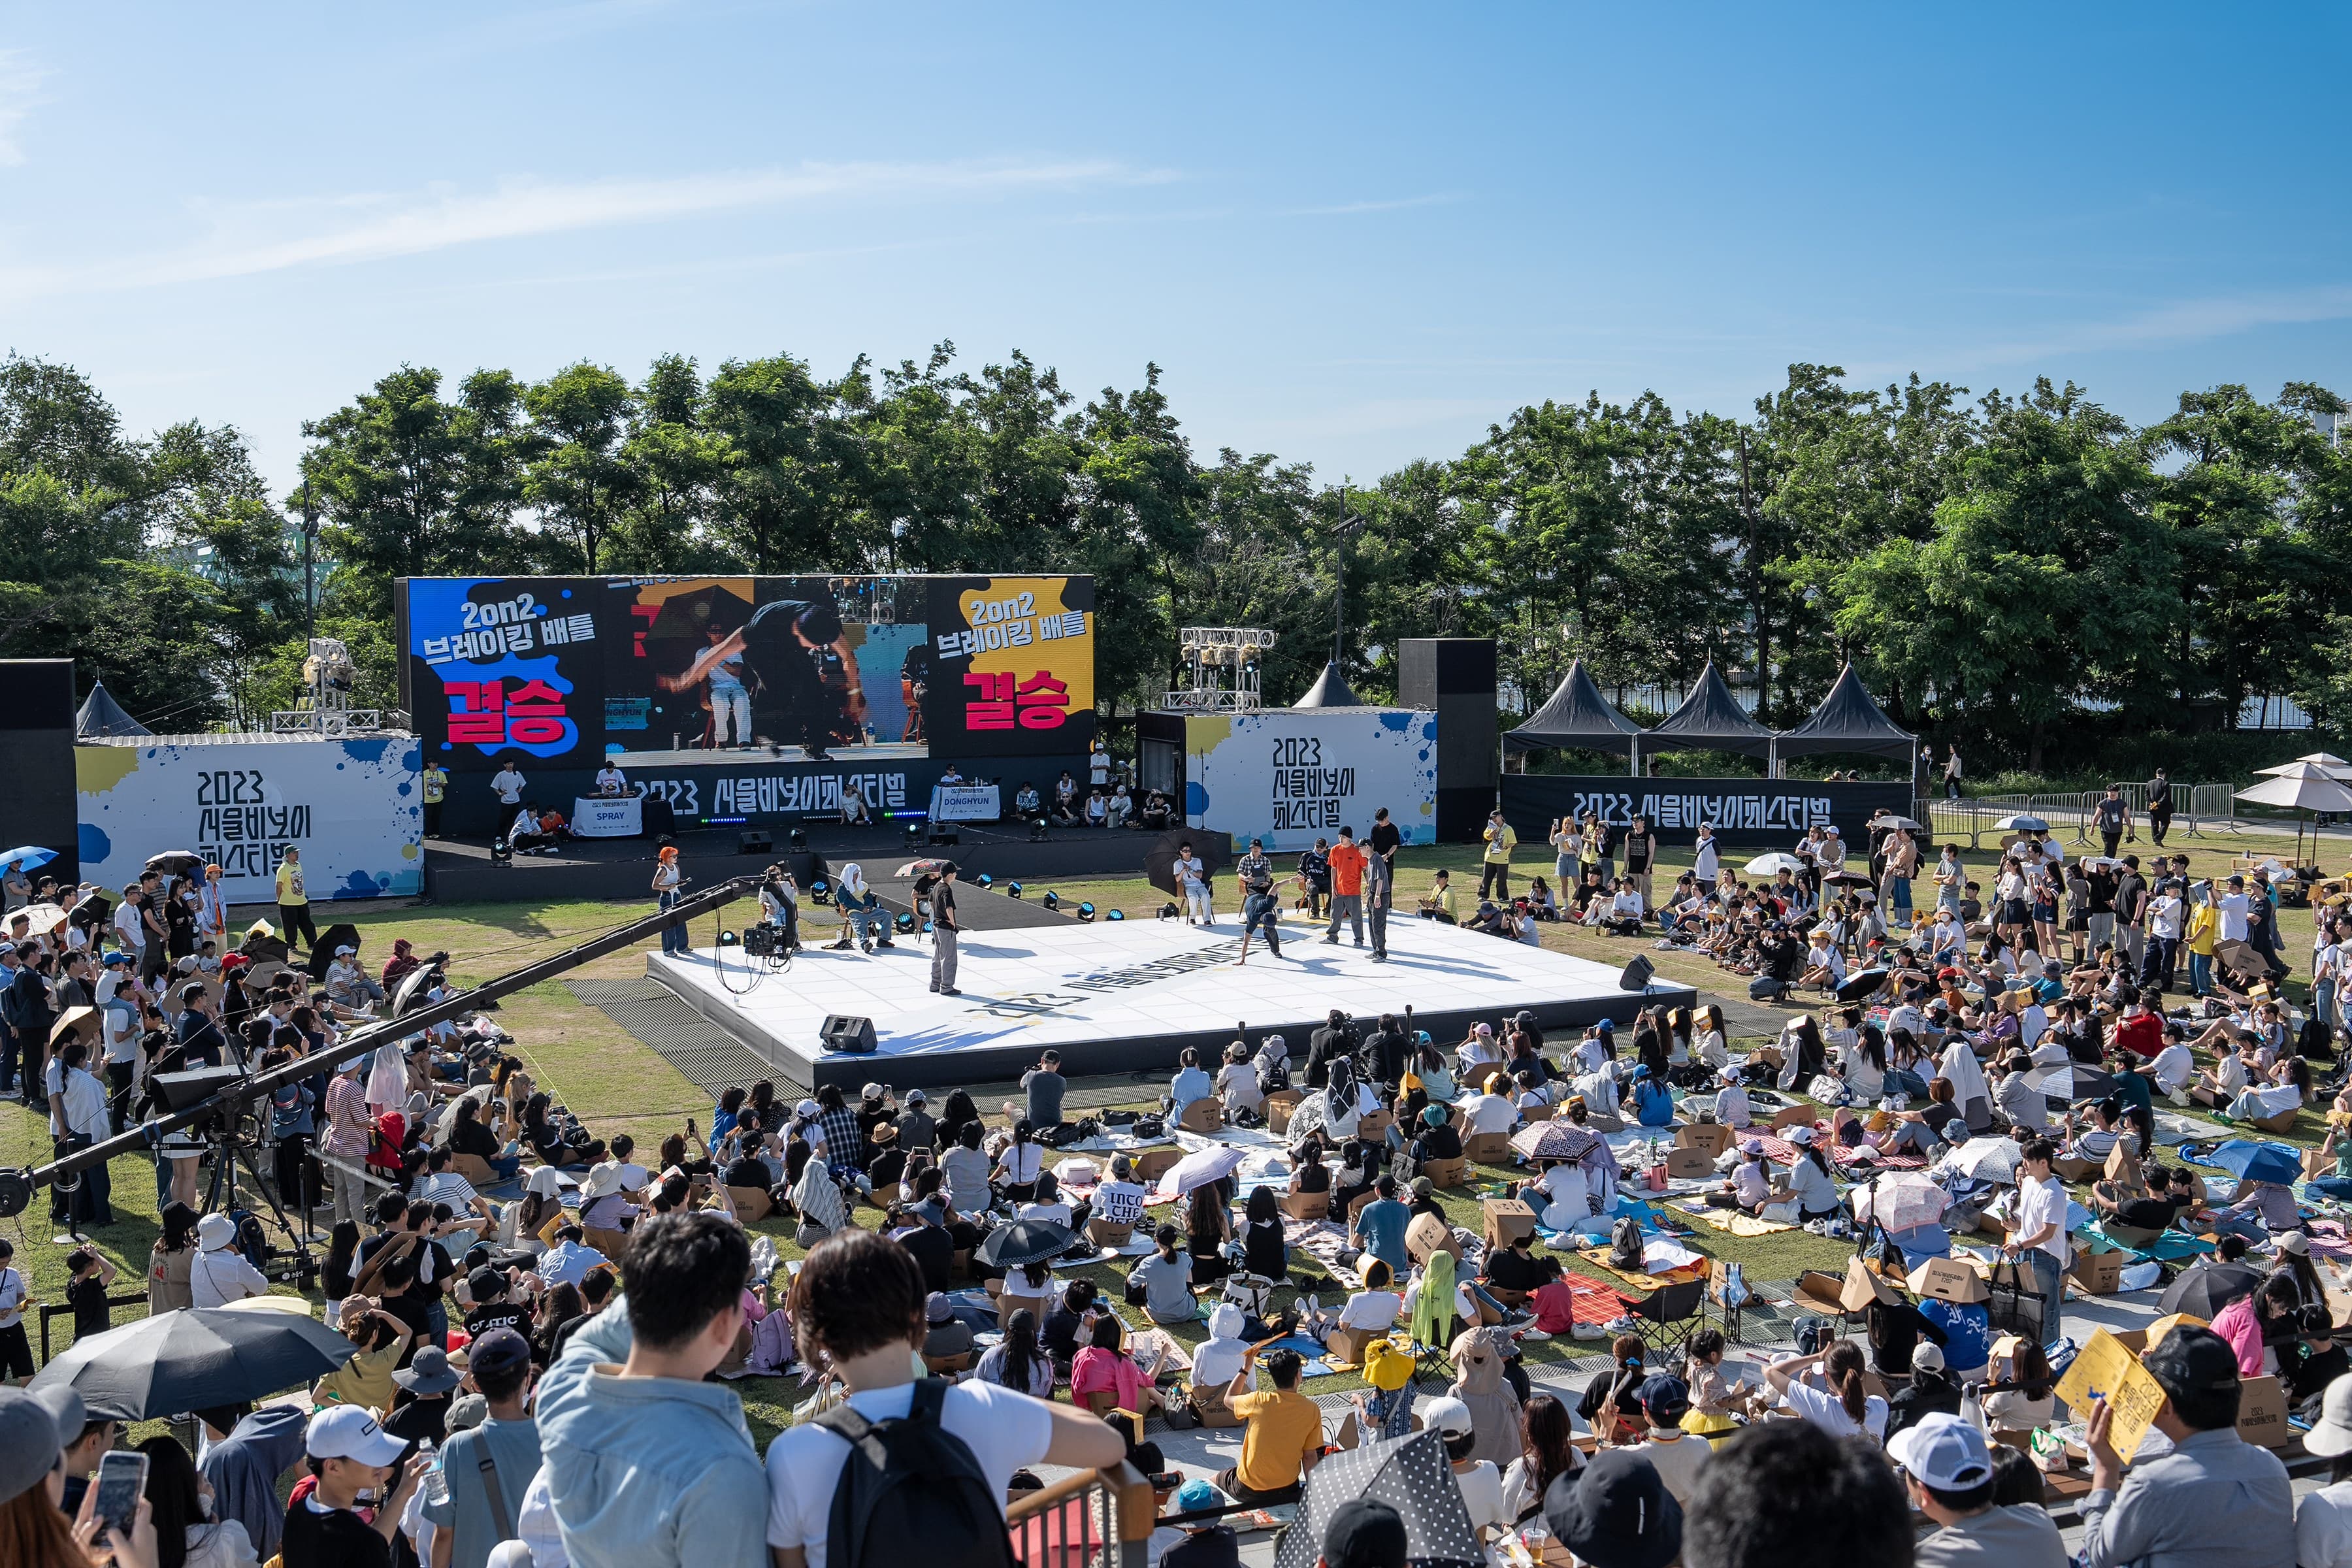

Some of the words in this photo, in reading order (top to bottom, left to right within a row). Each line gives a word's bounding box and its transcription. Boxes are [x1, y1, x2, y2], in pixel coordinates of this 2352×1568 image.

[461, 593, 538, 630] 2on2
[970, 591, 1037, 626] 2on2
[423, 623, 534, 665] 브레이킹
[541, 613, 596, 645] 배틀
[937, 620, 1034, 659] 브레이킹
[1038, 610, 1086, 641] 배틀
[444, 679, 566, 743] 결승
[964, 670, 1068, 730] 결승
[1273, 737, 1322, 766] 2023
[198, 770, 264, 806] 2023
[635, 779, 699, 815] 2023
[1273, 767, 1355, 798] 서울비보이
[596, 812, 625, 821] SPRAY
[944, 797, 989, 806] DONGHYUN
[1273, 799, 1340, 830] 페스티벌
[1575, 793, 1633, 826] 2023
[1641, 794, 1831, 830] 서울비보이페스티벌
[199, 805, 311, 842] 서울비보이
[1110, 1192, 1143, 1207] INTO
